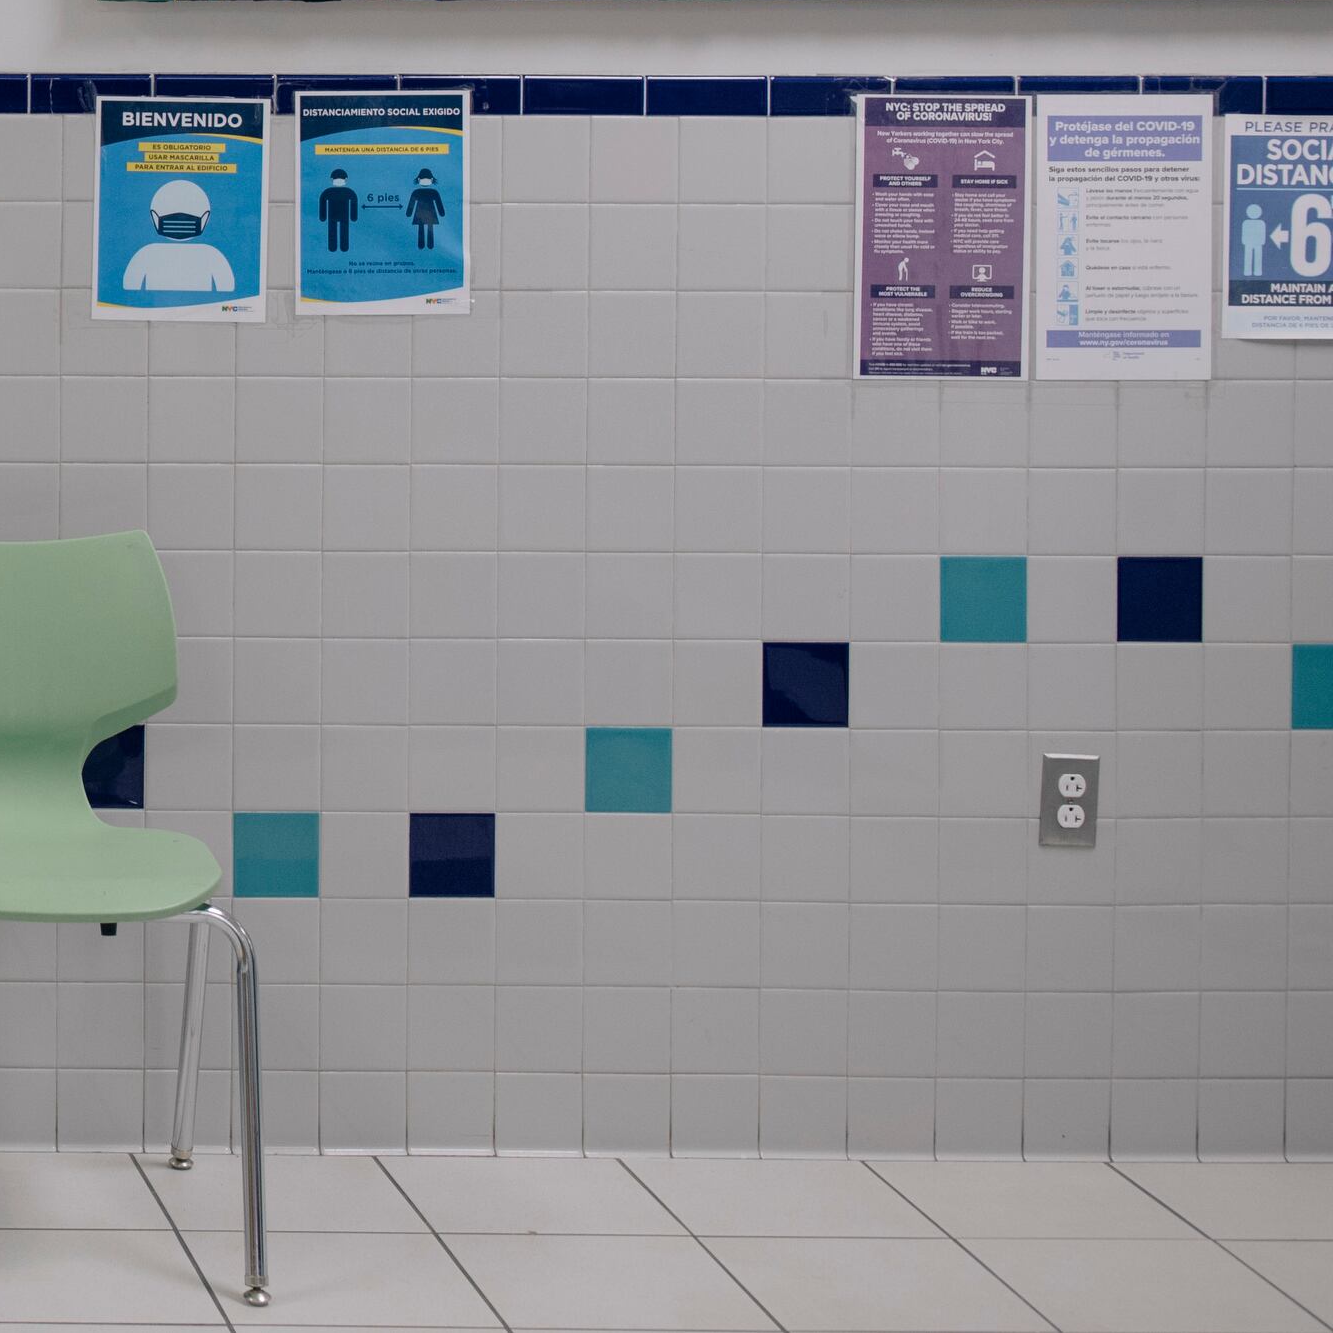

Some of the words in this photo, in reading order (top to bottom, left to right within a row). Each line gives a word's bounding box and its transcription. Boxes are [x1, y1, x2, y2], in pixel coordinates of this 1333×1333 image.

[303, 109, 385, 117] DISTANCIAMIENTO
[388, 108, 420, 116] SOCIAL
[886, 103, 910, 111] NYC:
[913, 103, 940, 112] STOP
[942, 104, 962, 112] THE
[964, 104, 1005, 112] SPREAD
[122, 112, 242, 128] BIENVENIDO
[897, 112, 911, 120] OF
[913, 112, 992, 121] CORONAVIRUS!
[1055, 121, 1111, 133] Protéjase
[1115, 121, 1133, 131] del
[1137, 122, 1195, 131] COVID-19
[1245, 122, 1302, 132] PLEASE
[1310, 122, 1333, 133] PR
[1049, 136, 1056, 146] y
[1060, 134, 1108, 146] detenga
[1113, 135, 1122, 143] la
[1126, 134, 1200, 146] propagación
[1085, 147, 1099, 156] de
[1103, 148, 1165, 159] gérmenes.
[1267, 139, 1333, 160] SOCI
[1237, 164, 1333, 185] DISTAN
[367, 193, 373, 201] 6
[378, 193, 399, 203] pies
[1271, 283, 1325, 292] MAINTAIN
[1242, 294, 1296, 304] DISTANCE
[1299, 295, 1331, 304] FROM
